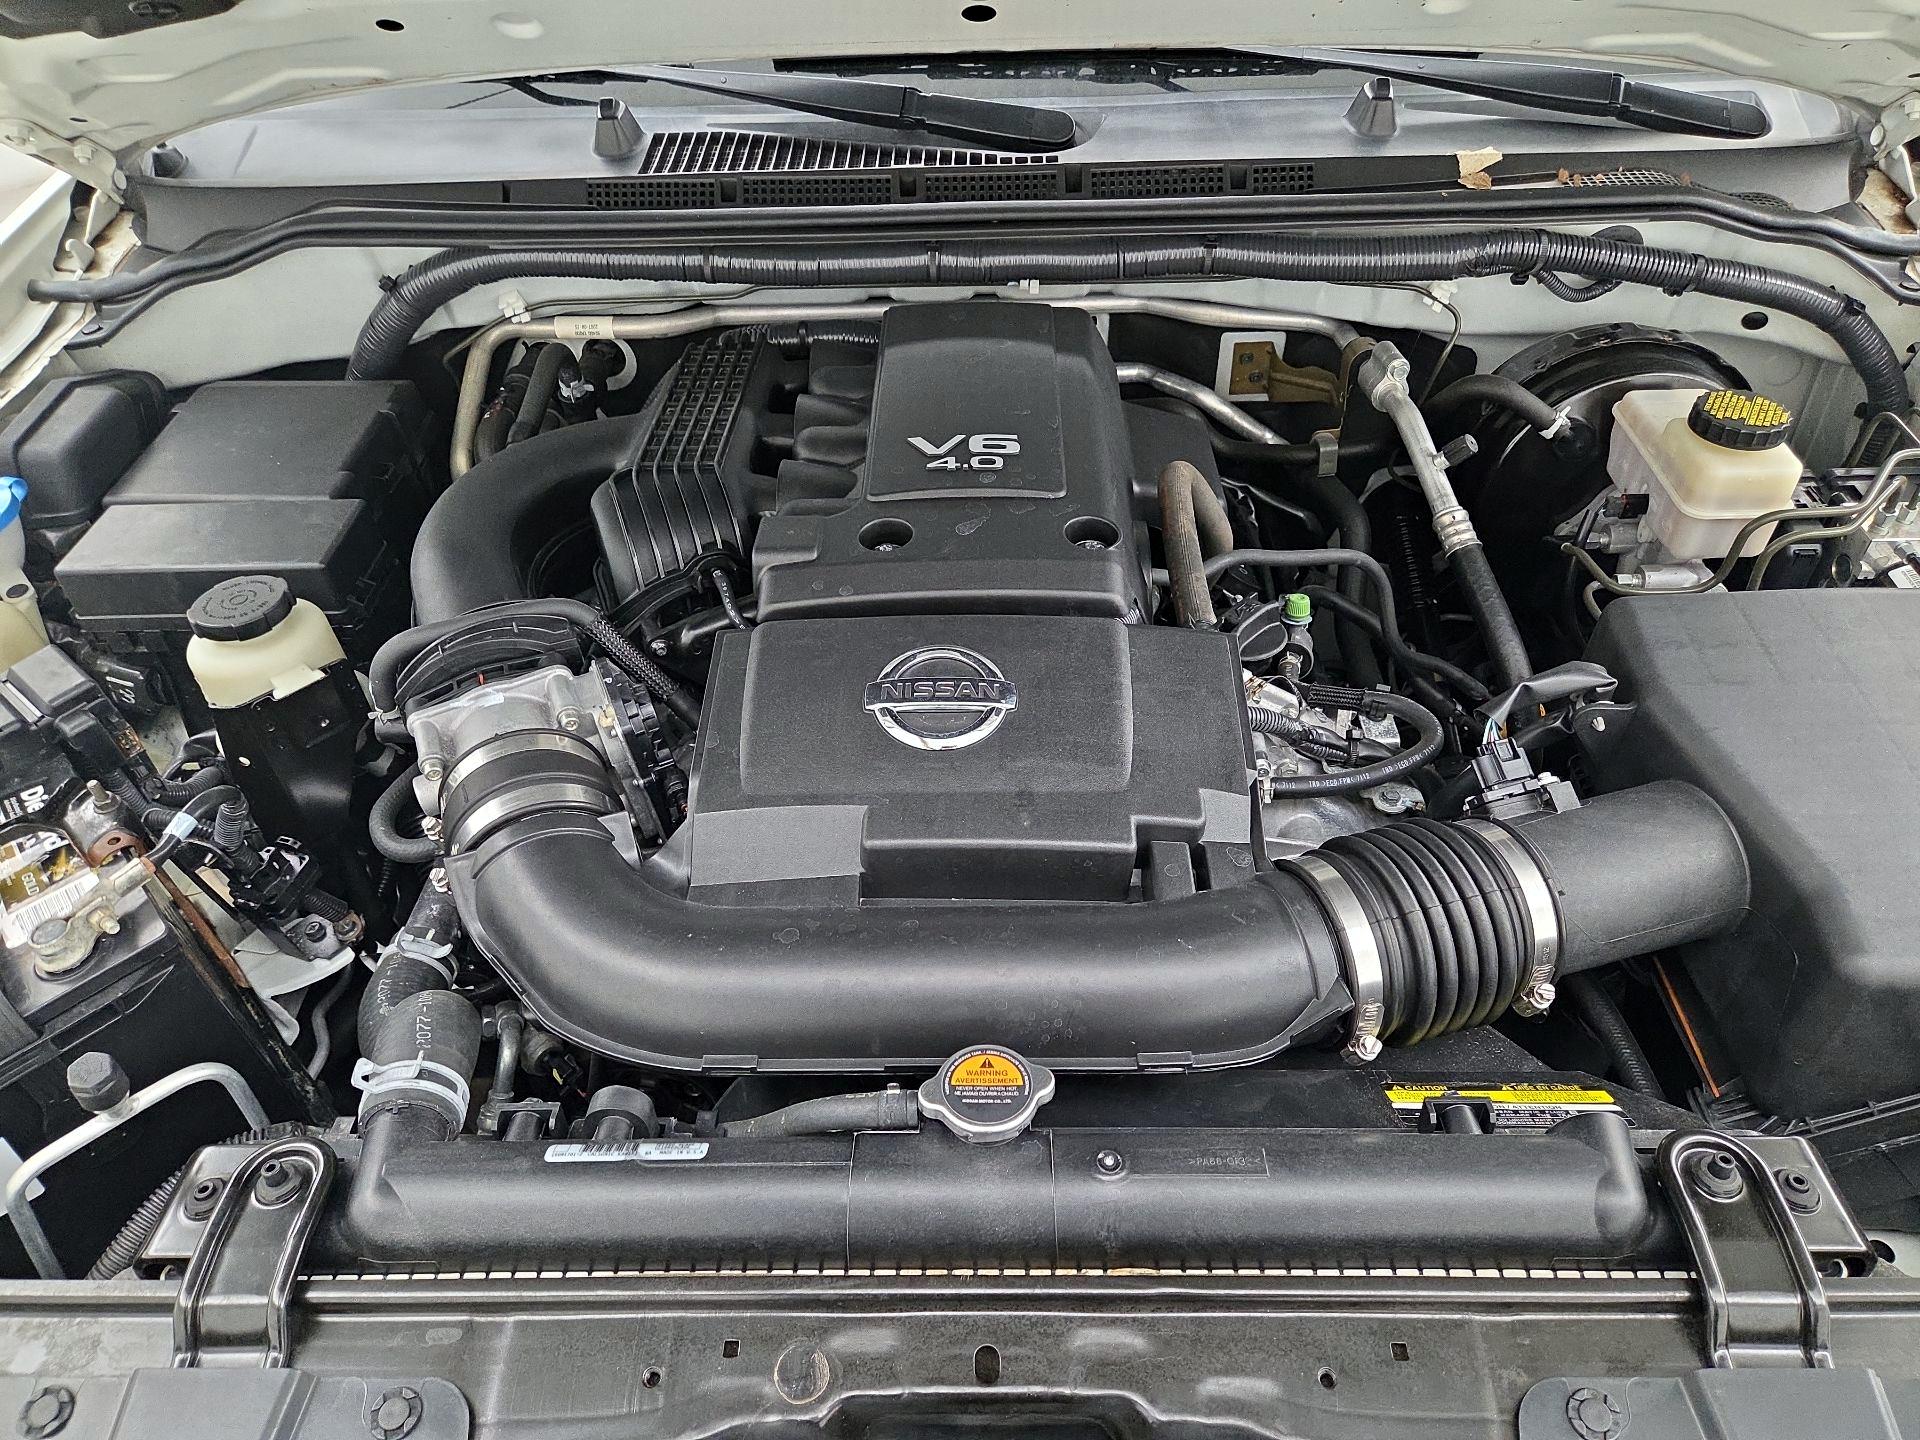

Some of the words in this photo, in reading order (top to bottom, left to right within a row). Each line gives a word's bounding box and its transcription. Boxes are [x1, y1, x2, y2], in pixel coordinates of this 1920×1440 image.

[907, 434, 1020, 456] V6
[926, 456, 1004, 470] 4.0
[881, 681, 1000, 699] NISSAN
[22, 871, 39, 896] GOLD
